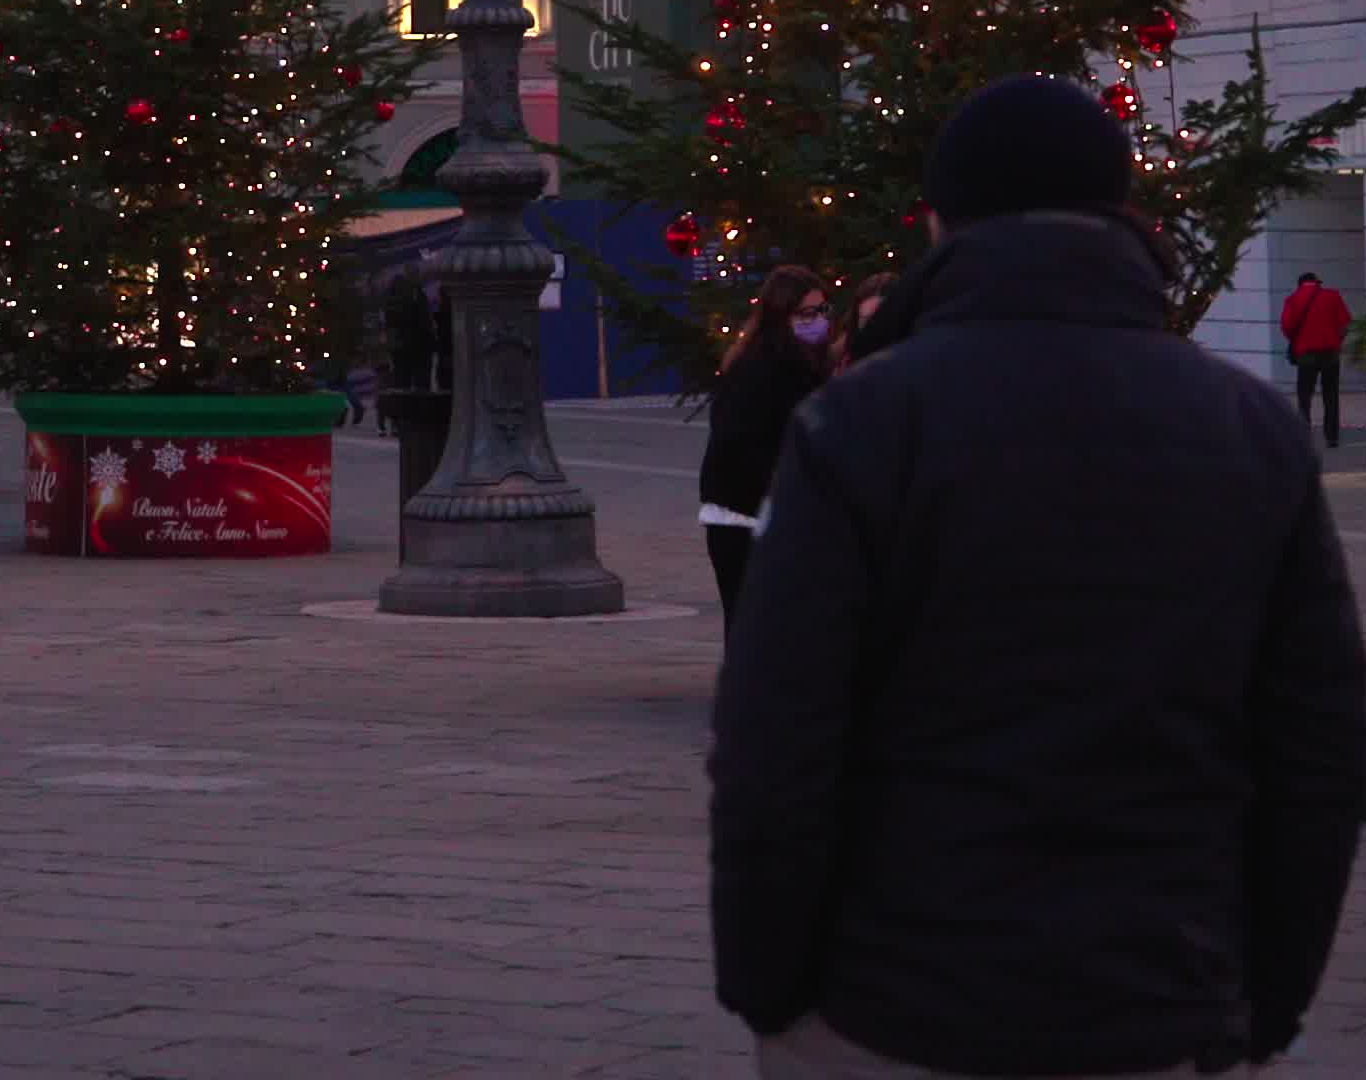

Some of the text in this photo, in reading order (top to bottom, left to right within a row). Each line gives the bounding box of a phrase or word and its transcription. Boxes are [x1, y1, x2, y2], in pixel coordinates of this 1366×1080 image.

[132, 496, 227, 518] Buon Natale
[156, 520, 205, 542] Felice
